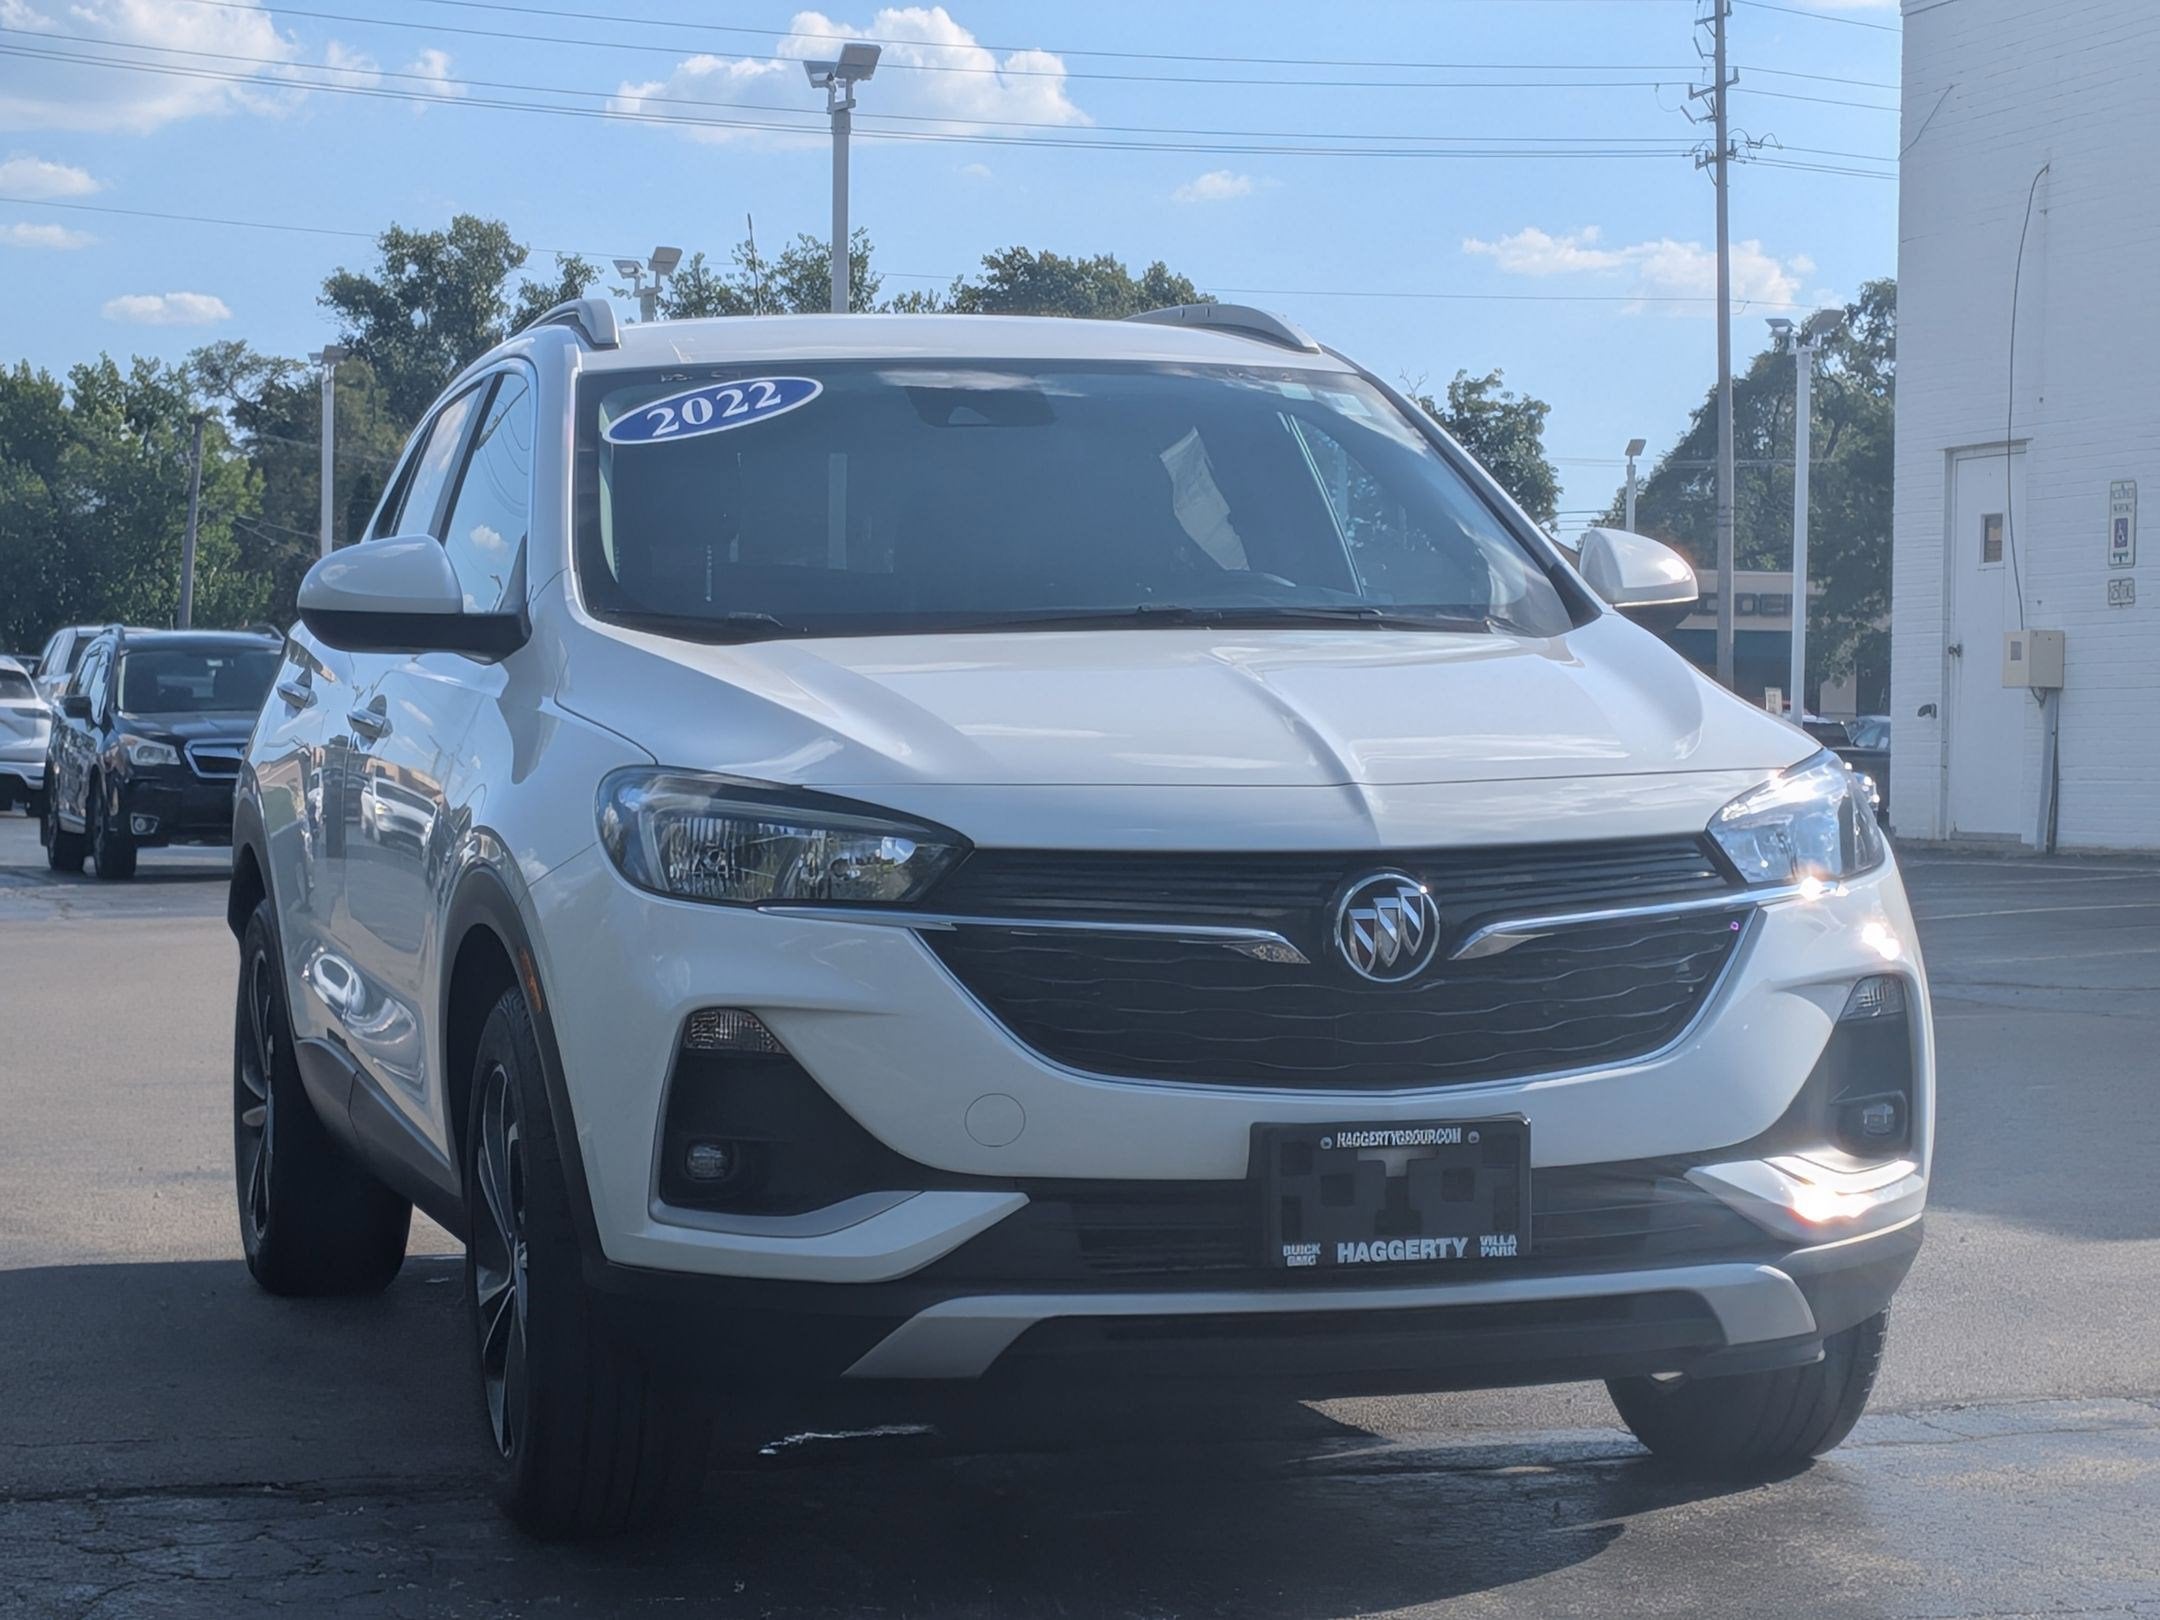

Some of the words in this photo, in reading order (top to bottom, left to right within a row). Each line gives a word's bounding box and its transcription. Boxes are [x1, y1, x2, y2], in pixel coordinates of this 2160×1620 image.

[647, 381, 782, 437] 2022
[1479, 1234, 1518, 1246] VILLA
[1283, 1243, 1321, 1257] BUICK
[1337, 1237, 1469, 1264] HAGGERTY
[1480, 1245, 1518, 1258] PARK
[1287, 1254, 1317, 1267] GMC
